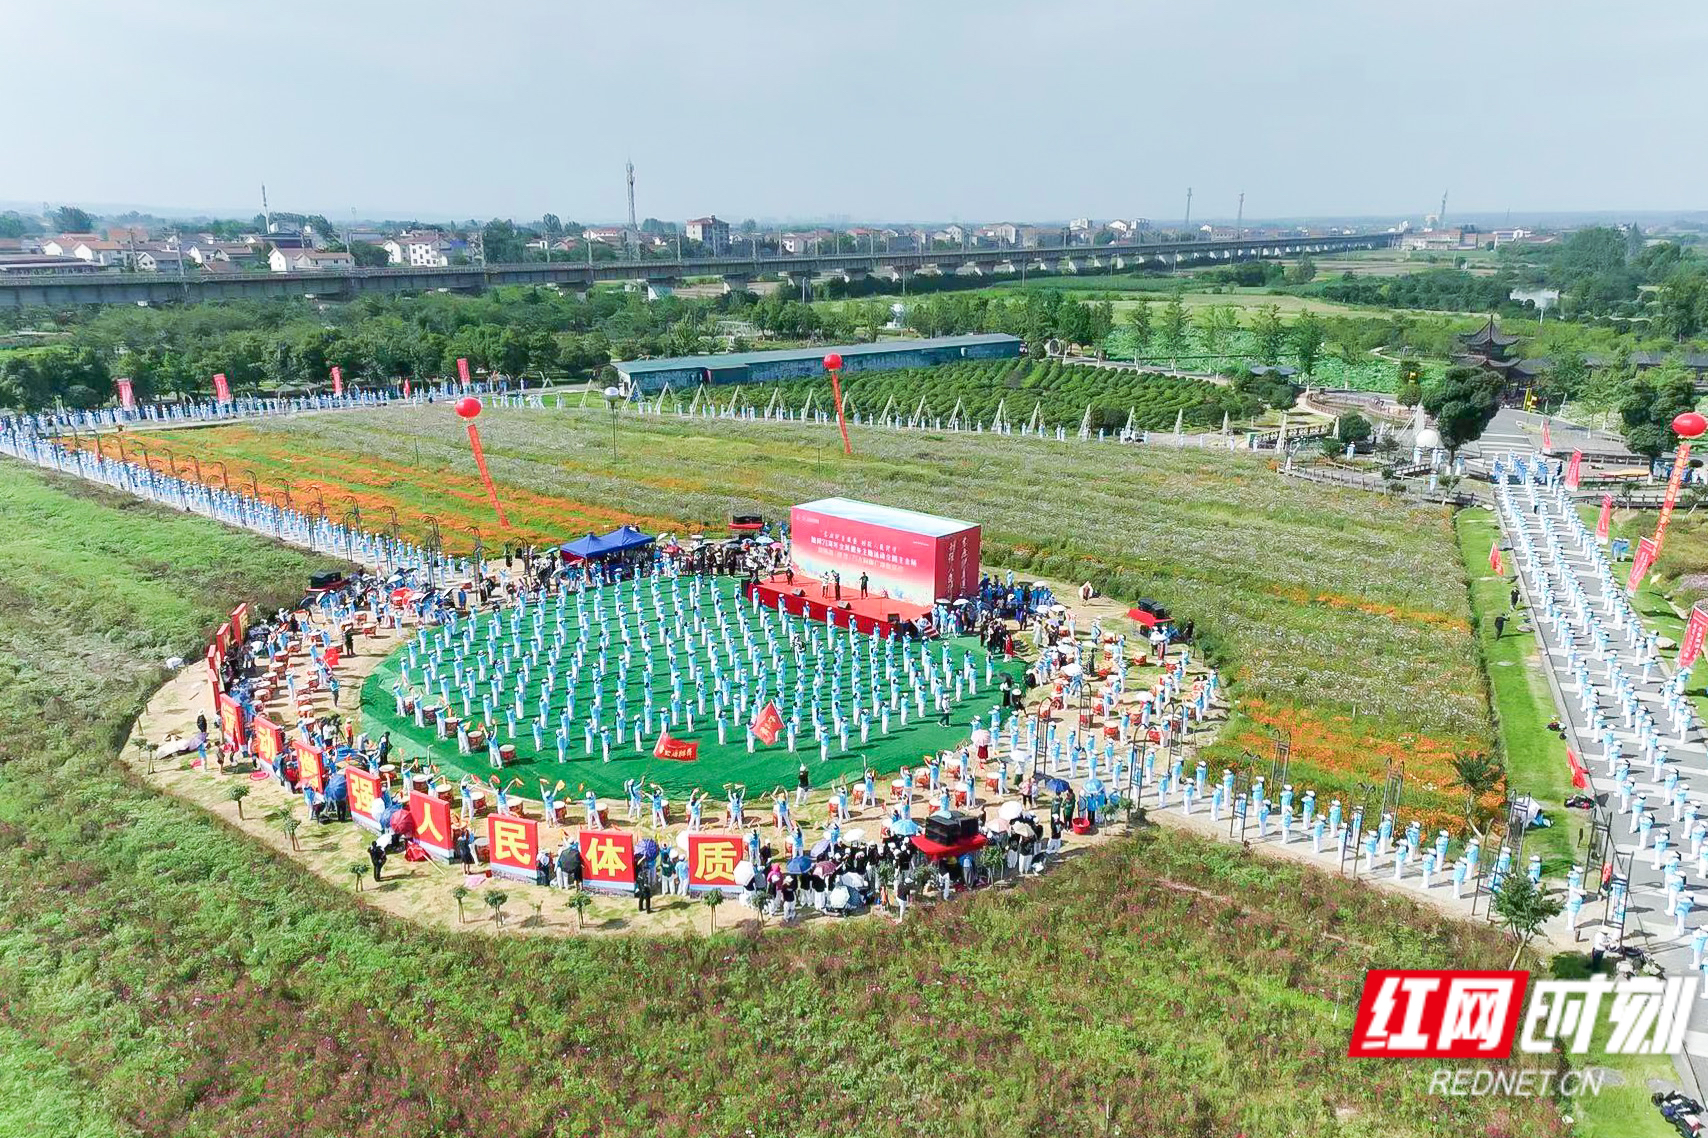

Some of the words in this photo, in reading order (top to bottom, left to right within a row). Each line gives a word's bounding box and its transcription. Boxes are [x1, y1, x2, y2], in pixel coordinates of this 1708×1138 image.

[257, 726, 278, 762] 动
[350, 774, 376, 812] 强
[416, 802, 444, 842] 人
[494, 820, 532, 865] 民
[586, 837, 627, 877] 体
[695, 841, 737, 882] 质
